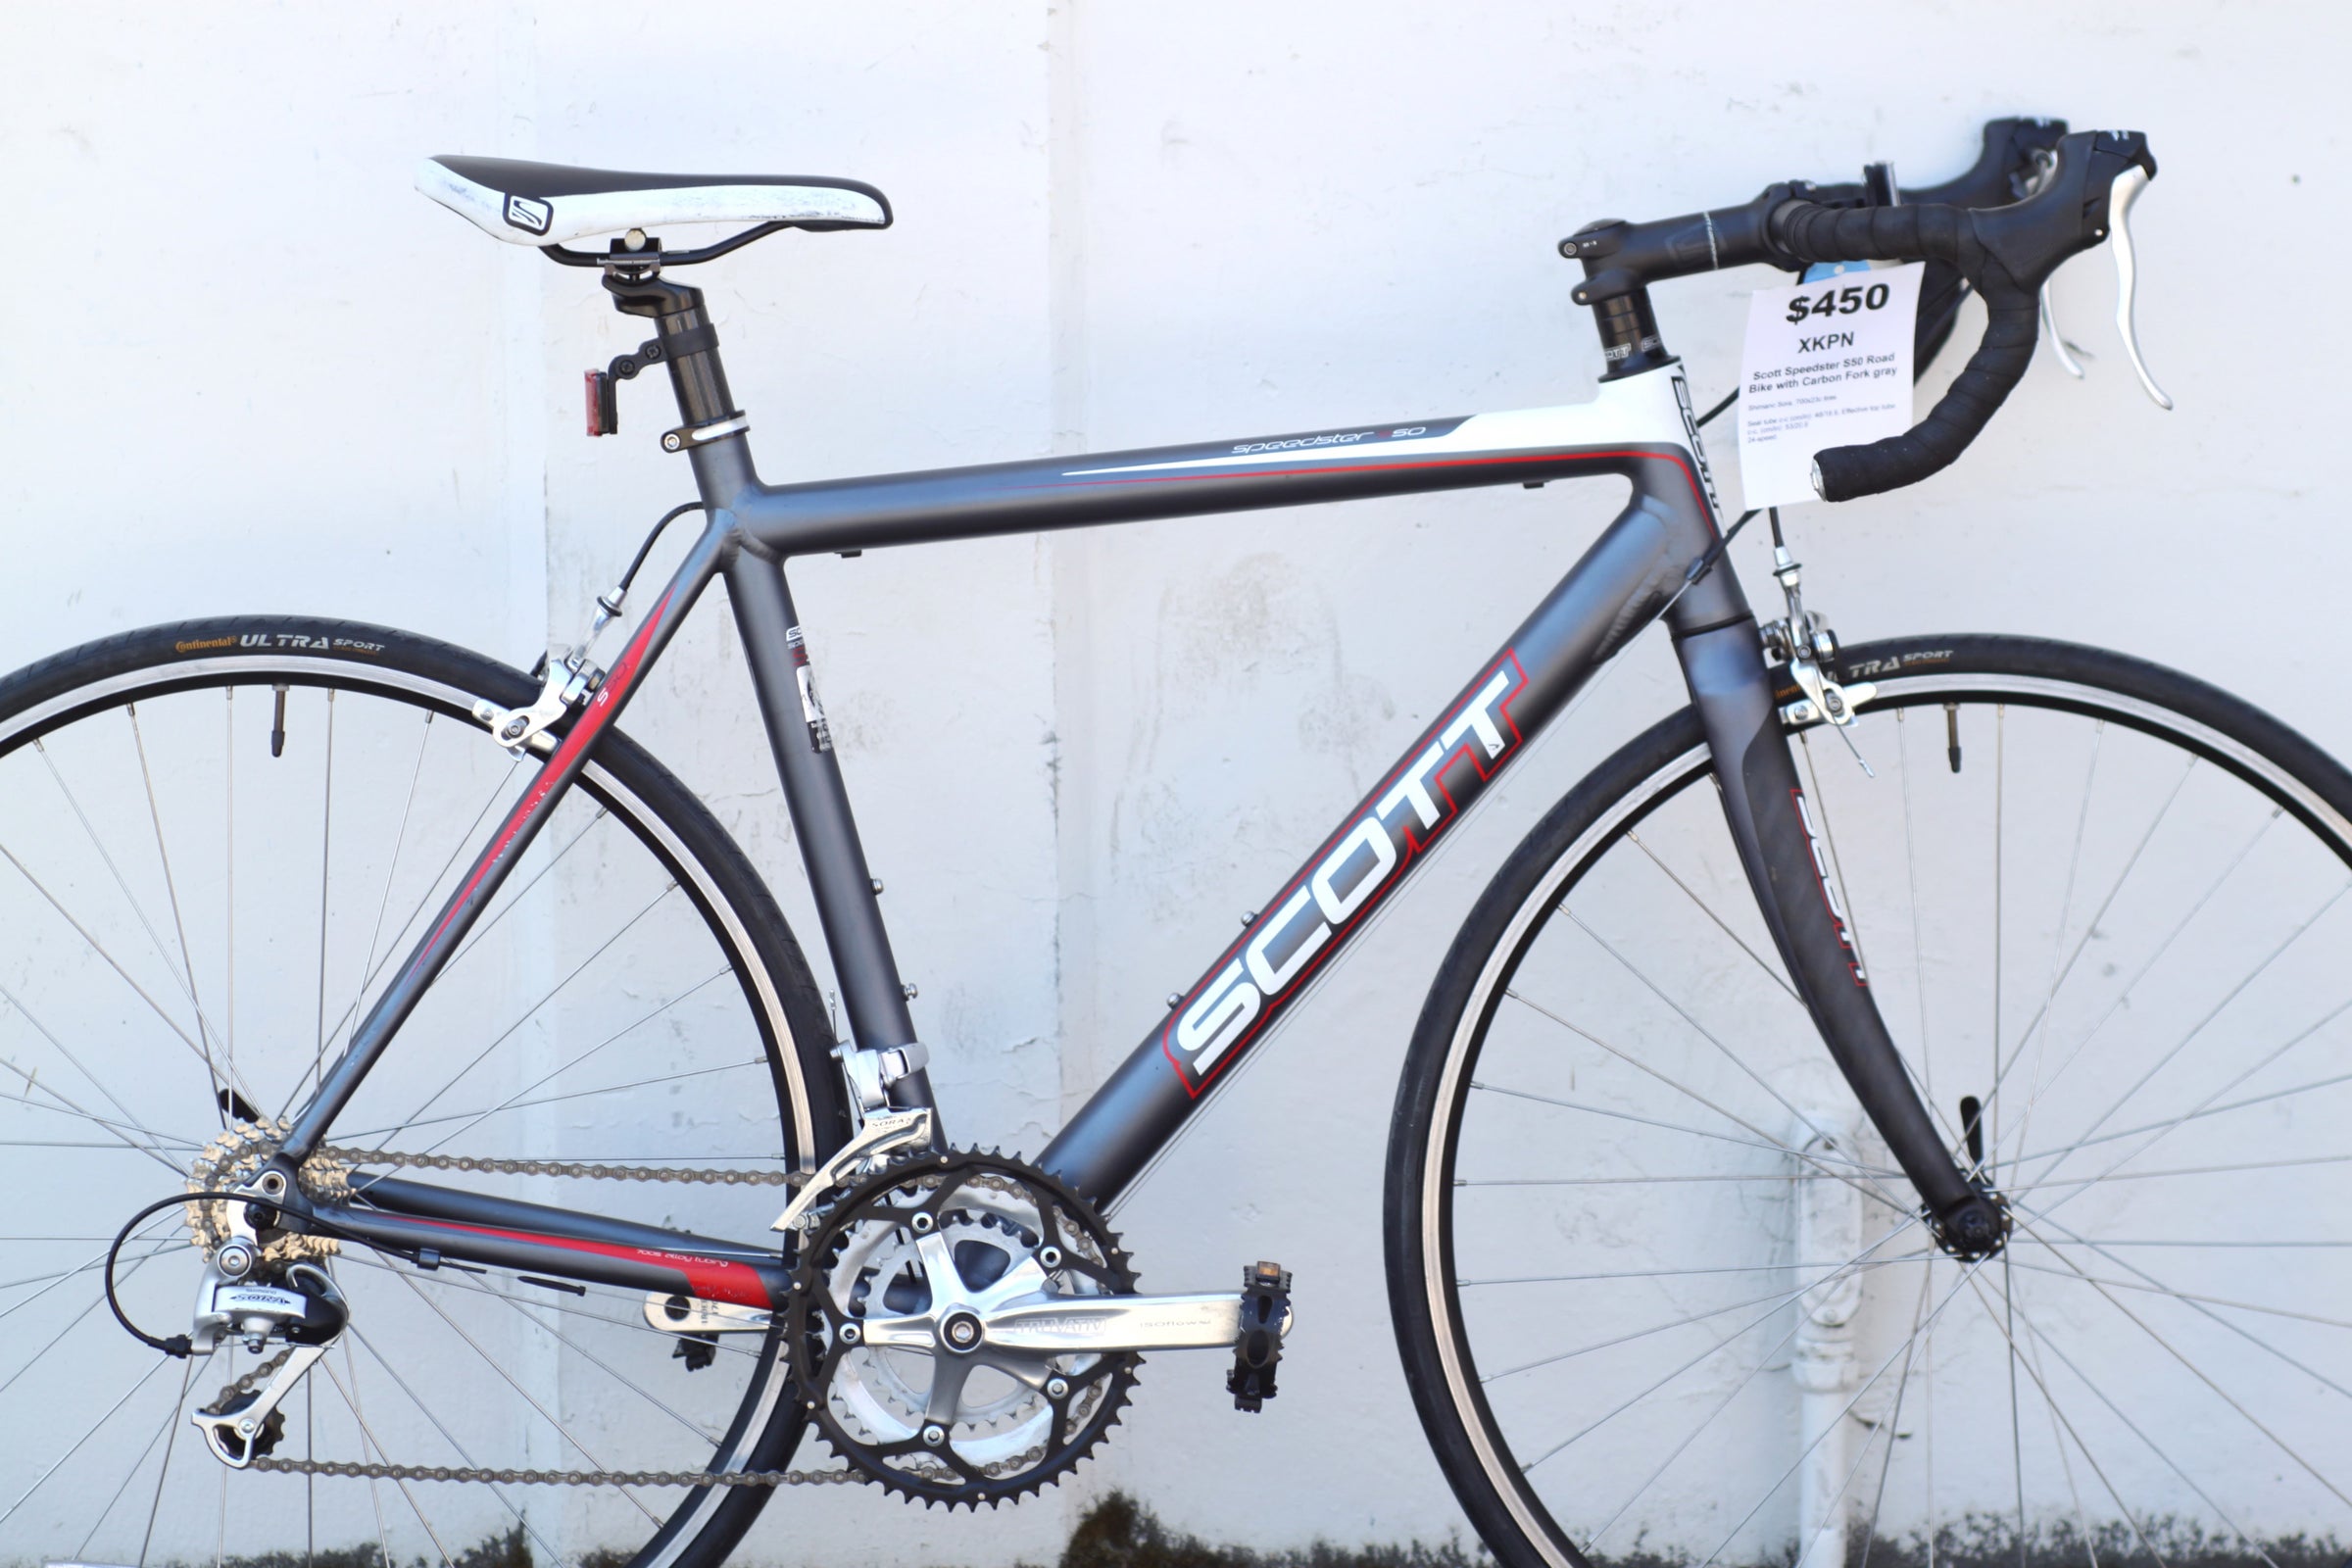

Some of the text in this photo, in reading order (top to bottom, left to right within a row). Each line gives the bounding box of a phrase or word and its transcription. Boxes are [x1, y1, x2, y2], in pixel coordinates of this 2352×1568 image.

[1786, 283, 1890, 325] $450
[1797, 331, 1854, 354] XKPN
[1753, 353, 1895, 380] Scott Speedster S50 Road
[1749, 367, 1897, 393] Bike with Carbon Fork gray
[1231, 431, 1375, 455] speedster
[239, 634, 329, 651] ULTRA
[333, 638, 385, 652] SPORT
[1902, 650, 1954, 662] SPORT
[1175, 669, 1510, 1076] SCOTT
[664, 1252, 694, 1263] alloy
[695, 1256, 729, 1268] tubing
